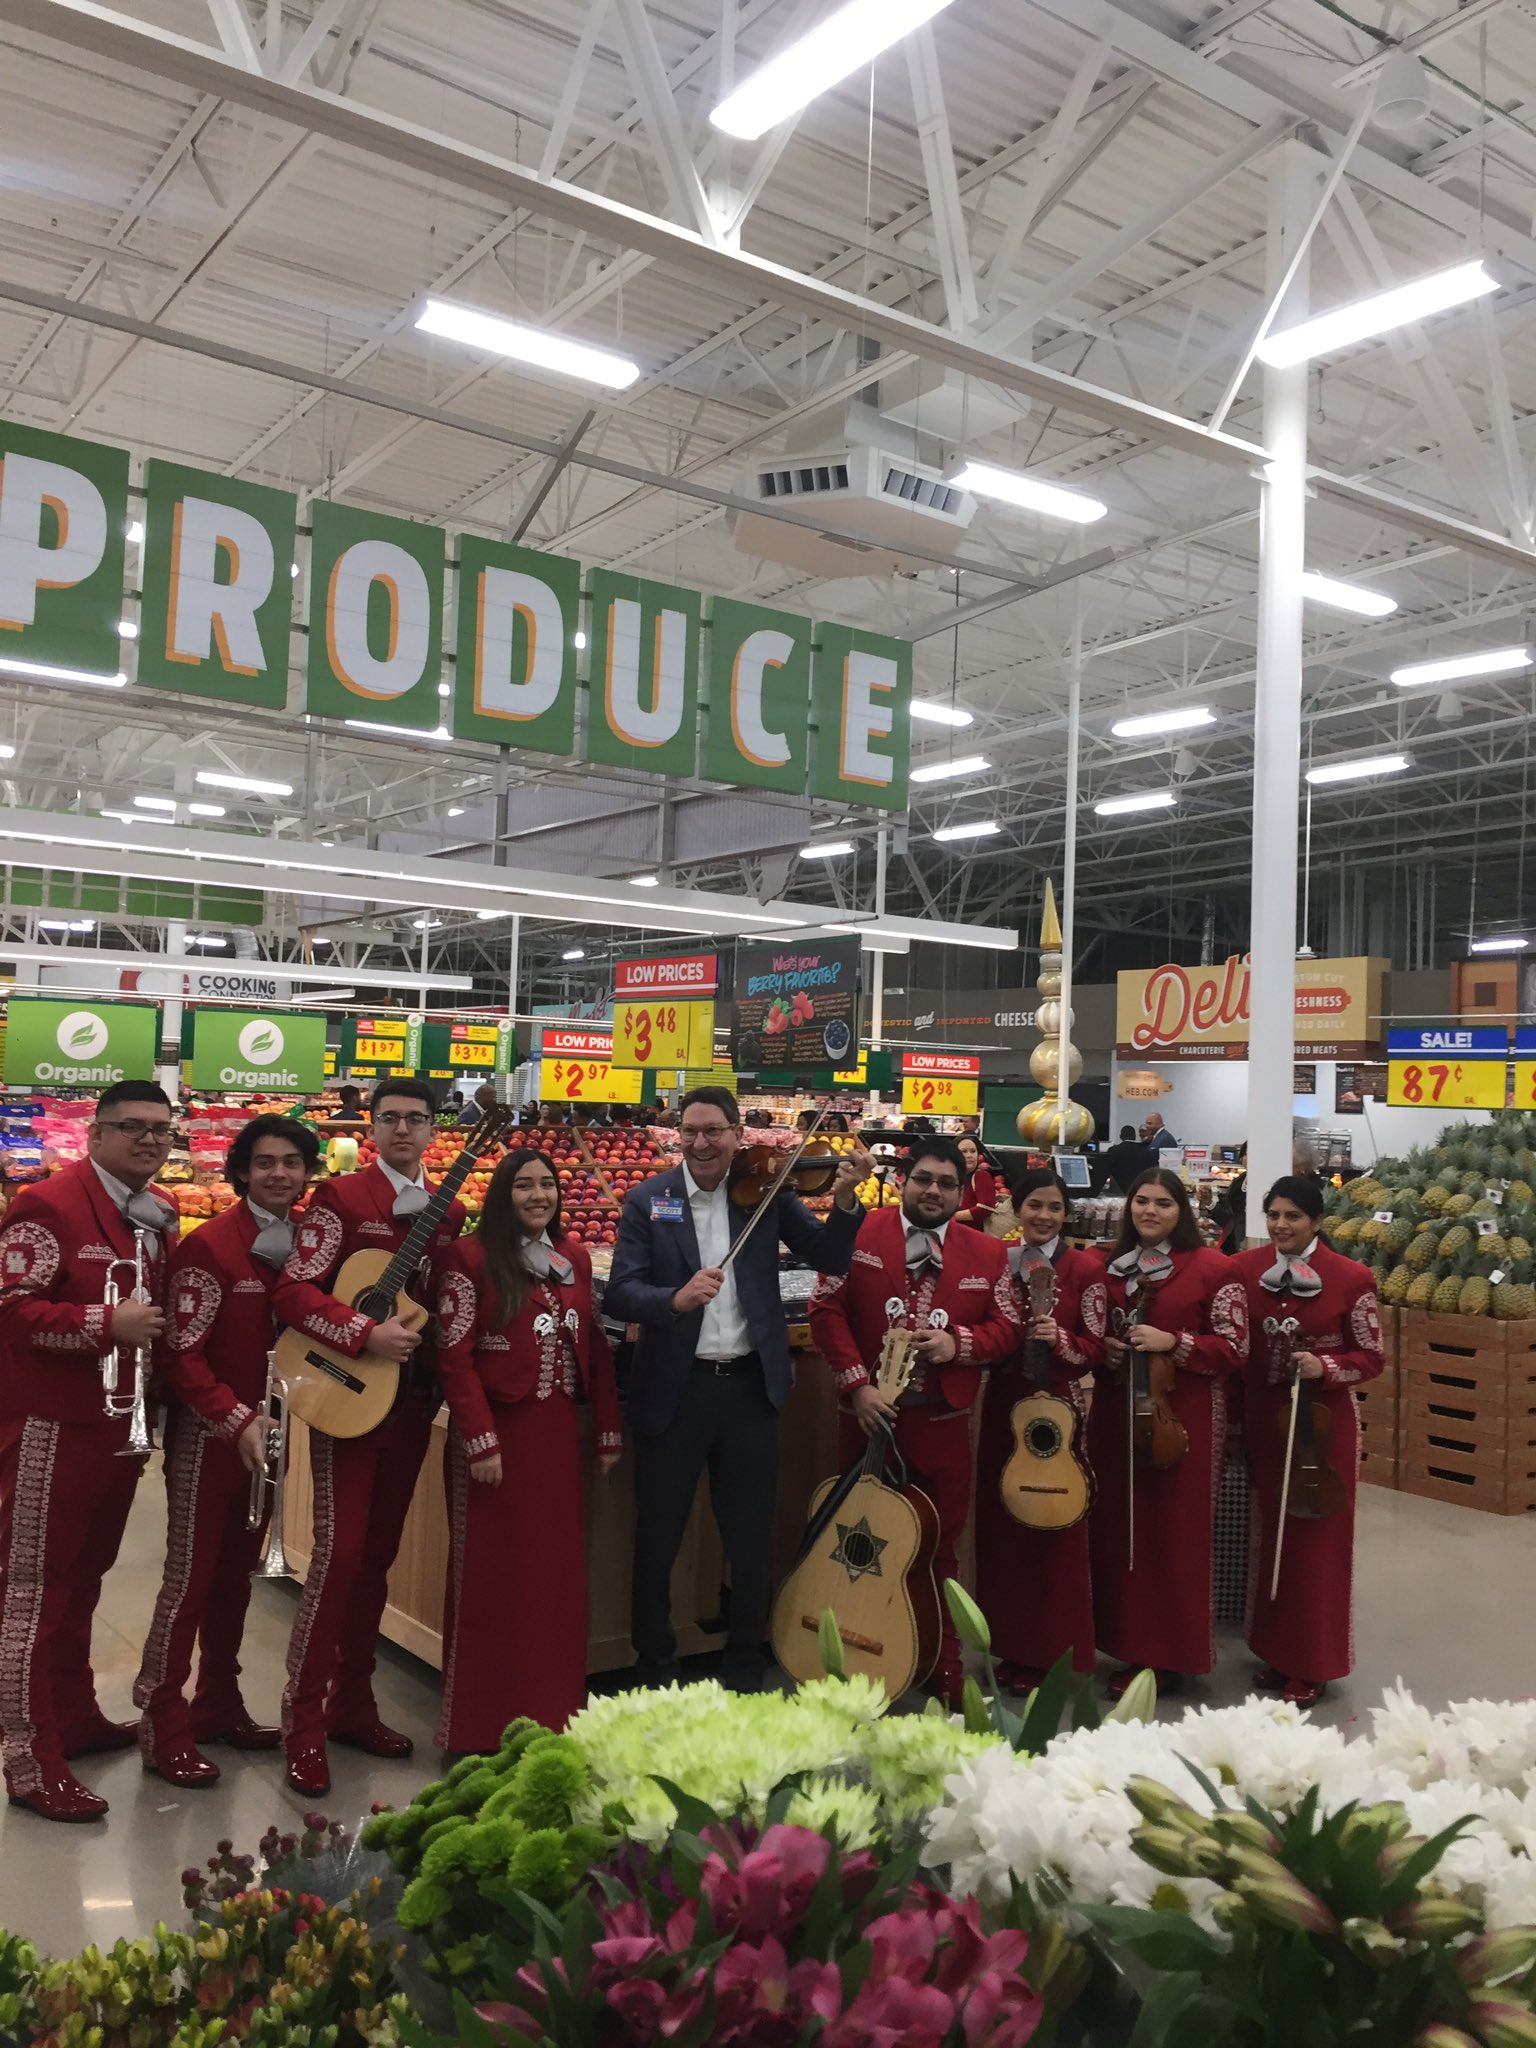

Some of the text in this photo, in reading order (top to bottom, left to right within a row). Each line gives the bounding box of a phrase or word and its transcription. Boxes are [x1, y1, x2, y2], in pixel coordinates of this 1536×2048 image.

[0, 451, 898, 788] PRODUCE
[626, 962, 704, 984] LOW PRICES
[199, 975, 276, 995] COOKING
[747, 973, 783, 996] BERRY
[1131, 952, 1251, 1050] Deli
[1295, 995, 1342, 1008] ESHNESS
[913, 1010, 935, 1028] and
[994, 1012, 1037, 1027] CHEESE
[409, 1029, 418, 1067] Organic
[555, 1035, 588, 1047] LOW
[1179, 1045, 1225, 1055] CHARCUTERIE
[1312, 1045, 1338, 1055] MEATS
[1420, 1032, 1472, 1048] SALE!
[500, 1034, 509, 1071] Organic
[911, 1055, 971, 1069] LOW PRICES
[34, 1062, 124, 1084] Organic
[219, 1067, 299, 1088] Organic
[1125, 1087, 1159, 1097] HEB.COM
